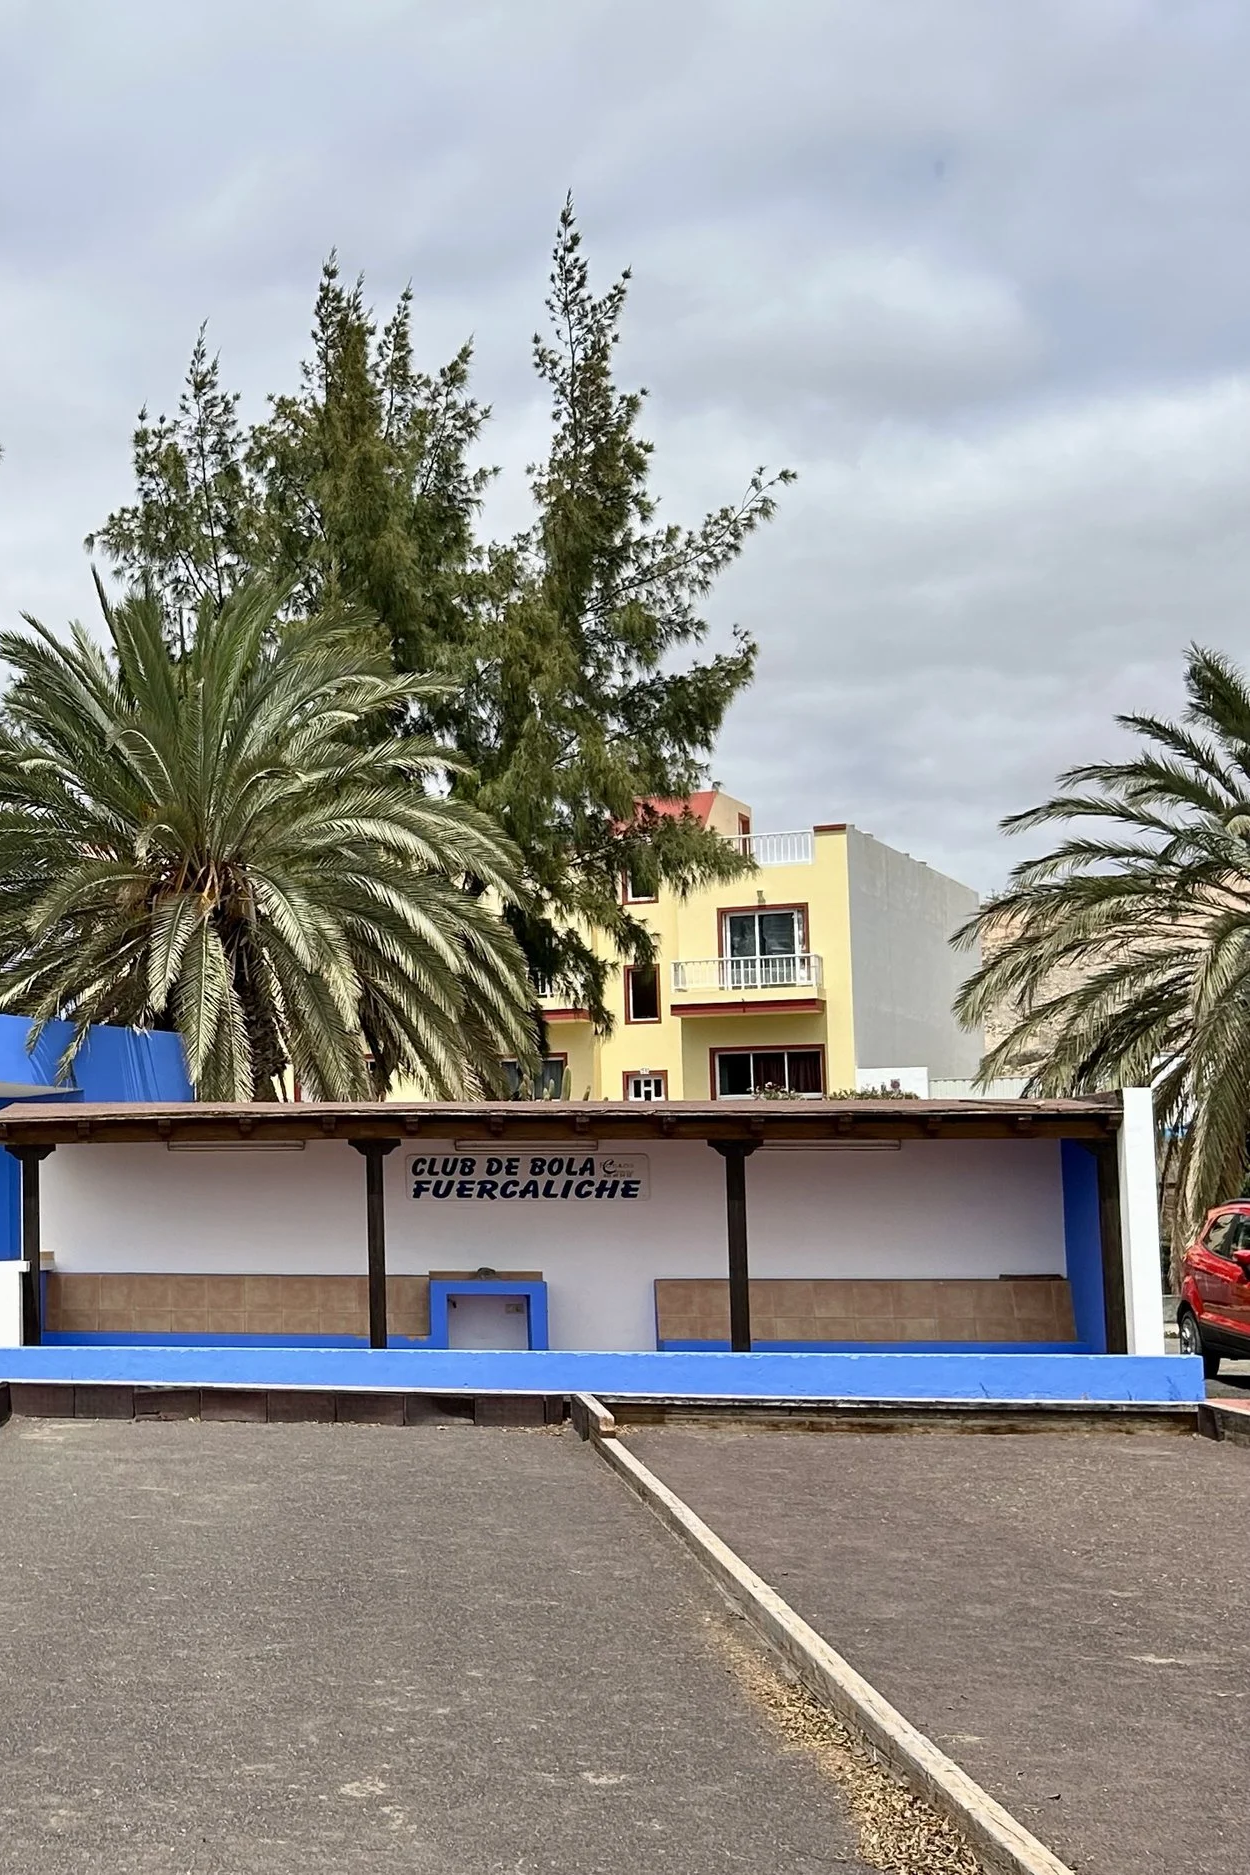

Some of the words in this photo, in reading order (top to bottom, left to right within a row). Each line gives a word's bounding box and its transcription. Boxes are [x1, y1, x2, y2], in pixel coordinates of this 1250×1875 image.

[411, 1157, 477, 1177] CLUB
[485, 1157, 521, 1177] DE
[529, 1157, 596, 1177] BOLA
[412, 1179, 642, 1200] FUERCALICHE
